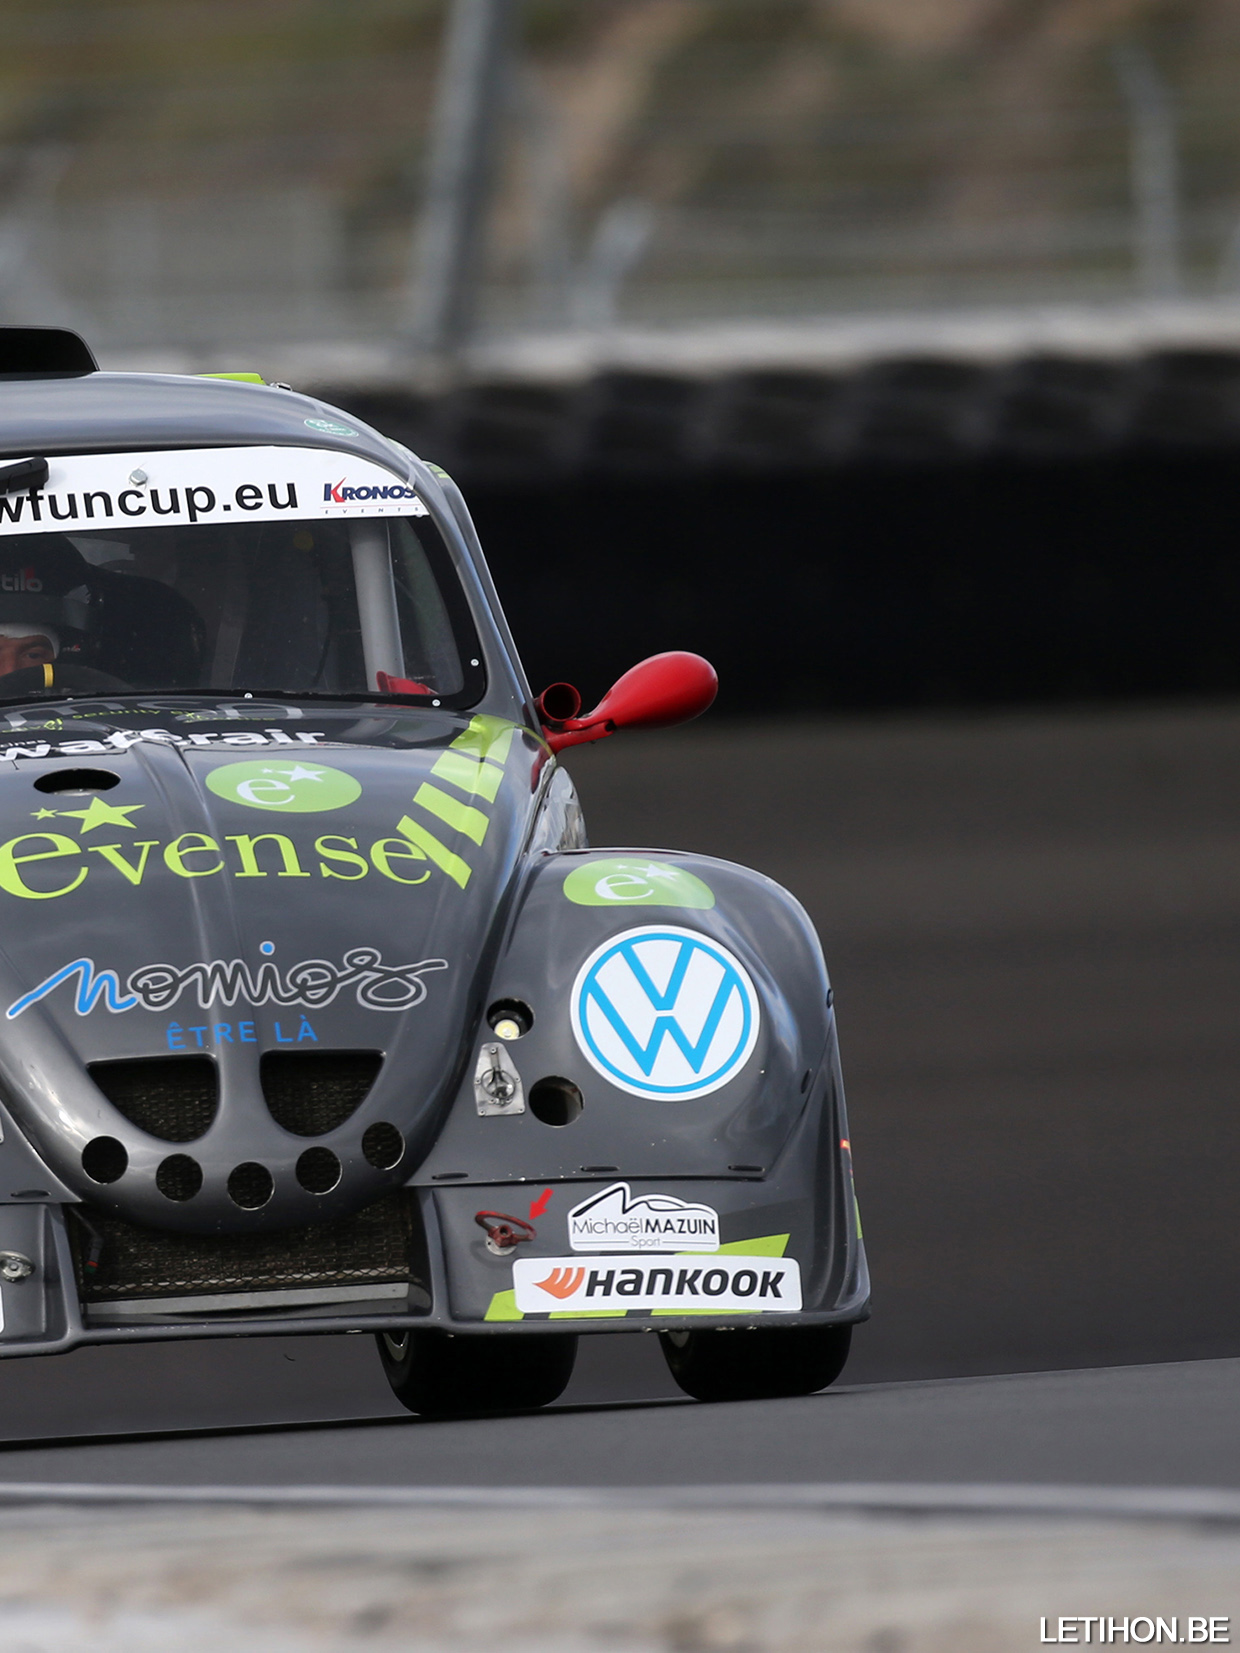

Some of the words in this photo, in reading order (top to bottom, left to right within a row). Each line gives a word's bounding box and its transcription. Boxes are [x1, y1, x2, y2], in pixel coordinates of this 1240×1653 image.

[323, 477, 417, 503] KRONOS
[6, 941, 449, 1019] nomios
[165, 1020, 258, 1050] ÊTRE
[275, 1014, 318, 1044] LÀ
[572, 1216, 643, 1236] Michaël
[644, 1217, 716, 1236] MAZUIN
[630, 1234, 661, 1250] Sport
